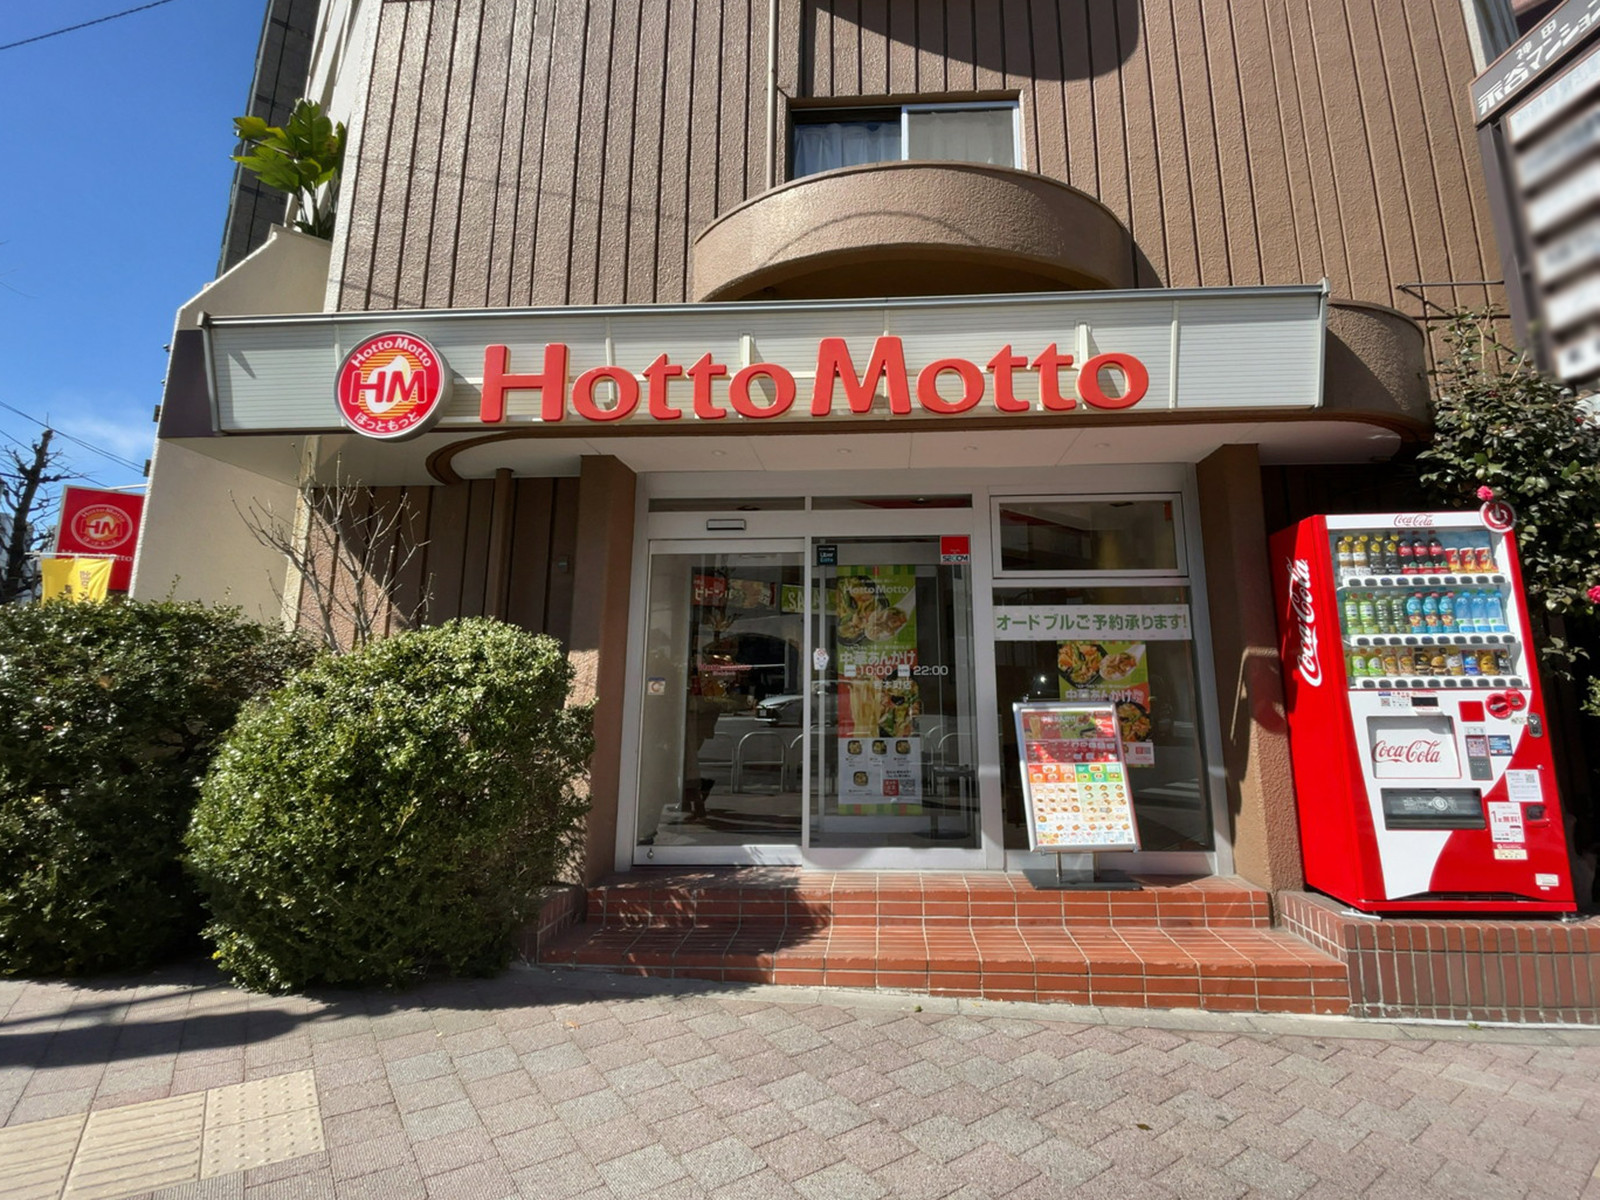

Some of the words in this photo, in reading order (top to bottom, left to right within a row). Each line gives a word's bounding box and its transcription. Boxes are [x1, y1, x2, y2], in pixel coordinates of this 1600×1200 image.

[349, 369, 428, 405] HM
[354, 411, 420, 432] ほっともっと
[996, 613, 1188, 631] オードブルご予約承ります!
[859, 665, 893, 676] 10:00
[912, 665, 949, 676] 22:00
[1371, 739, 1442, 764] Coca-Cola
